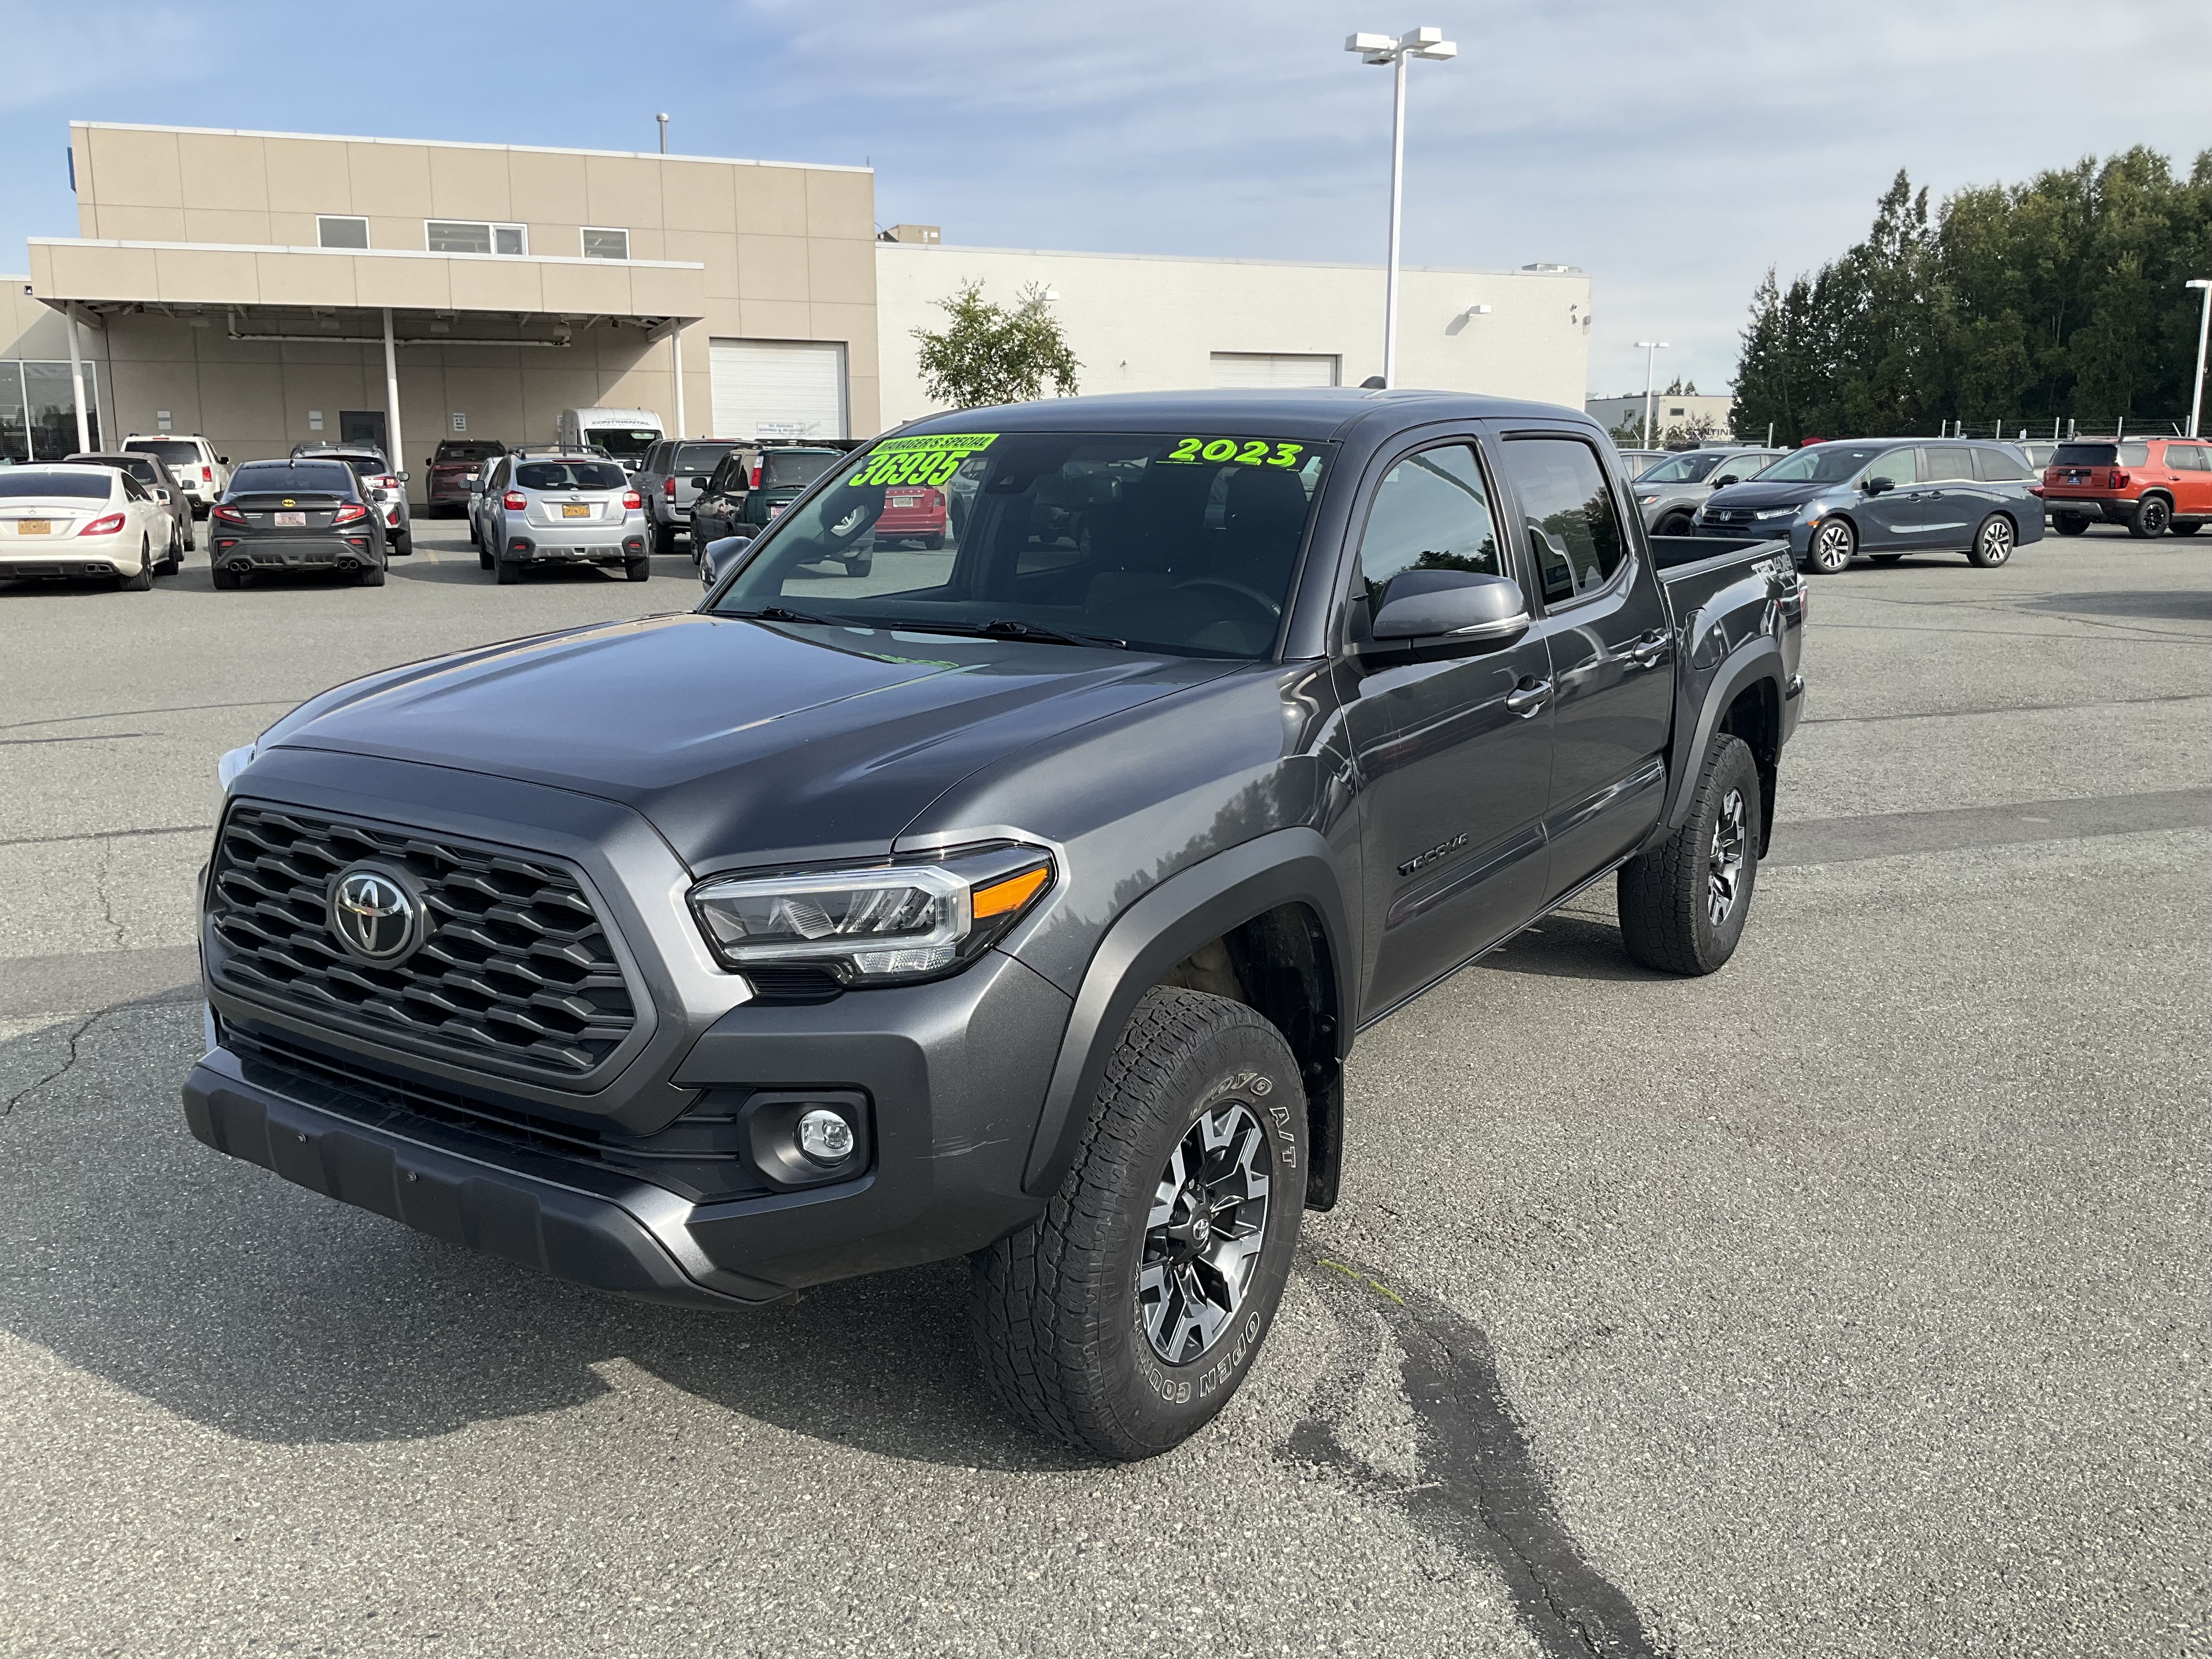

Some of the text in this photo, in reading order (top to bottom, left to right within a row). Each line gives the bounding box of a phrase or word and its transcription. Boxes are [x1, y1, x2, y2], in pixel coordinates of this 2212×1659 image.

[876, 436, 992, 452] MANAGER'S SPECIAL
[1169, 438, 1303, 467] 2023
[848, 451, 971, 486] 36995
[1751, 559, 1778, 583] TRD
[1269, 1107, 1296, 1168] A/T
[1199, 1311, 1260, 1398] OPEN
